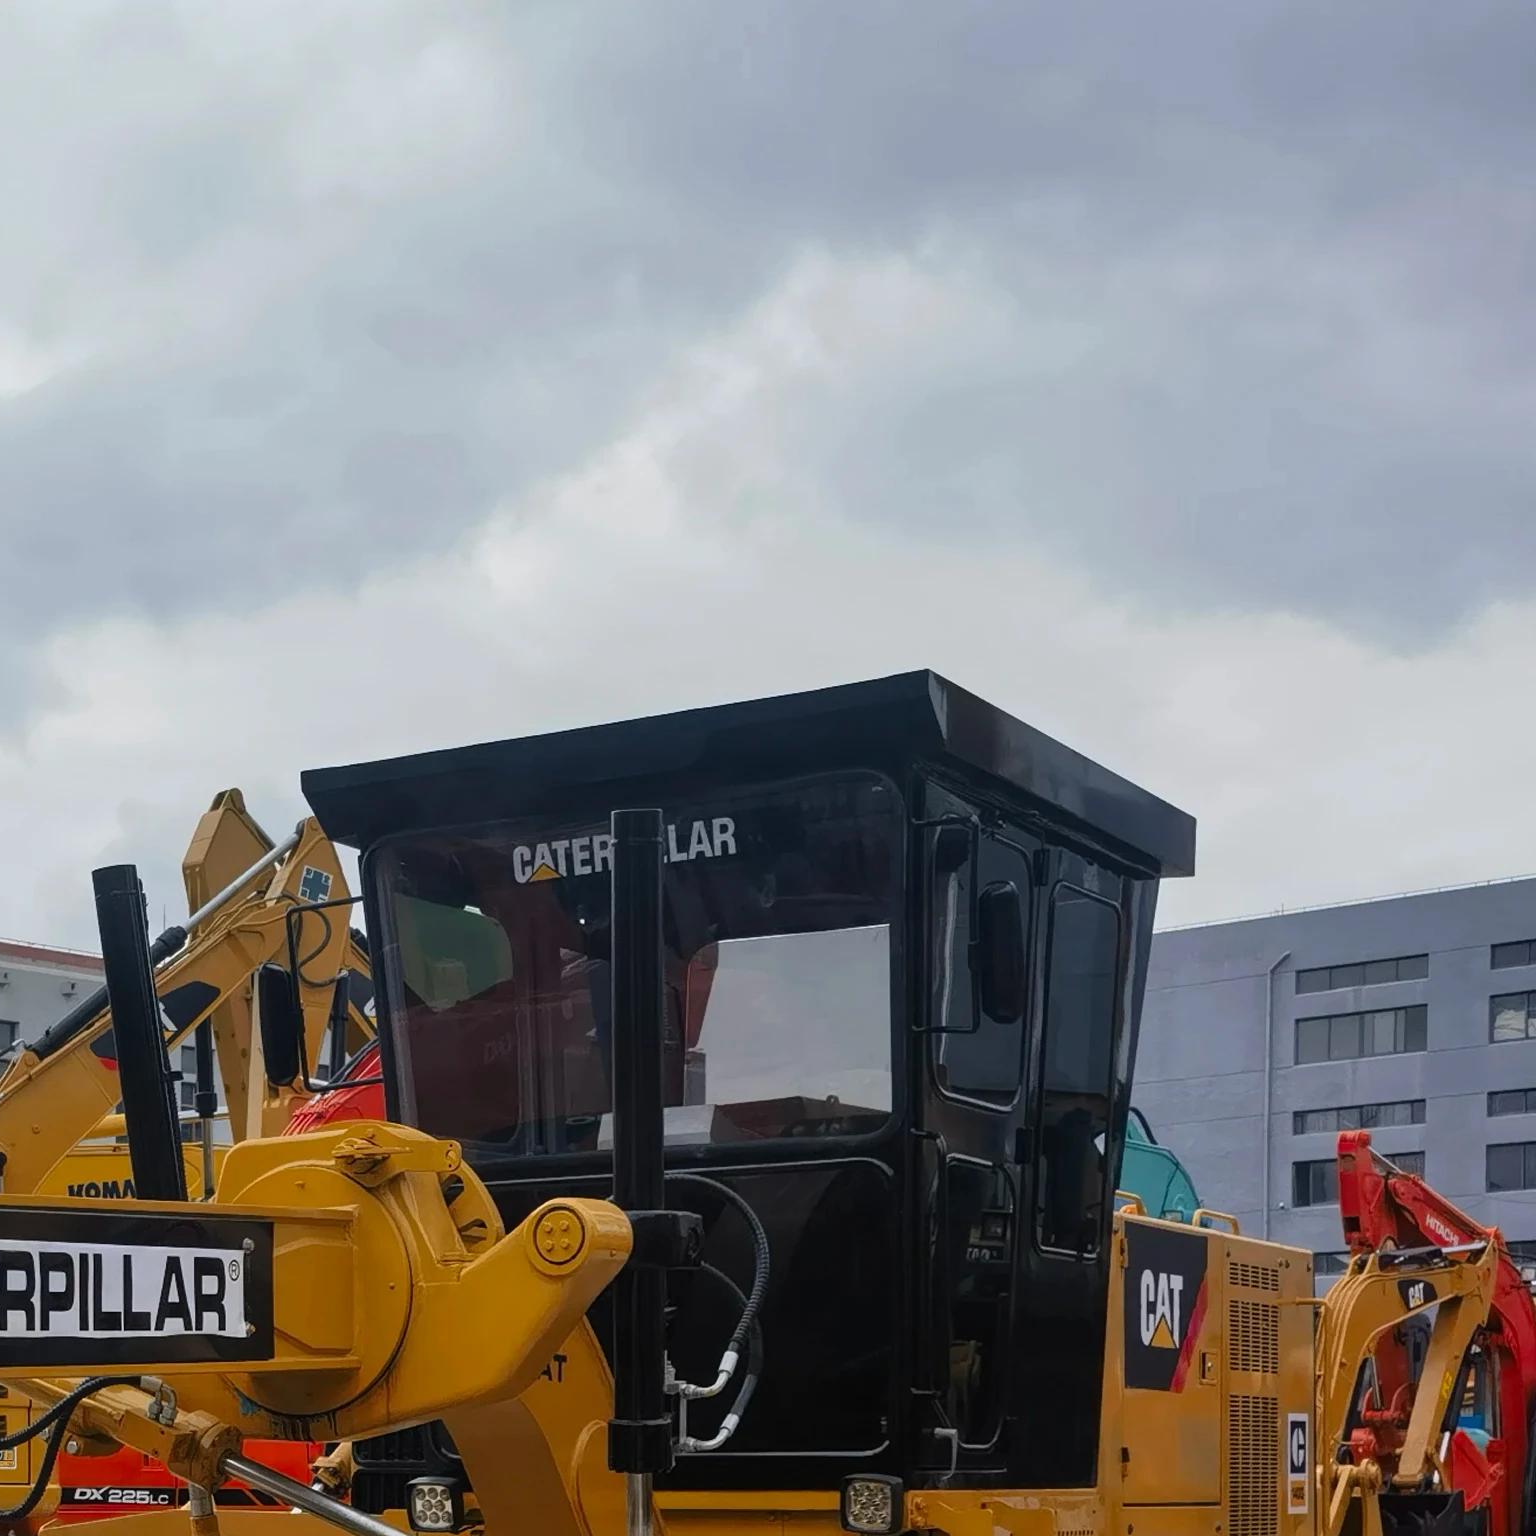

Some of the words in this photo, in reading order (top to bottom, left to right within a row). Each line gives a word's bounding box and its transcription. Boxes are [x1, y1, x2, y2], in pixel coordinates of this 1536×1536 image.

[512, 817, 737, 884] CATERLAR
[1425, 1213, 1460, 1247] HITACHI
[1140, 1268, 1184, 1349] CAT
[1408, 1282, 1425, 1309] CAT
